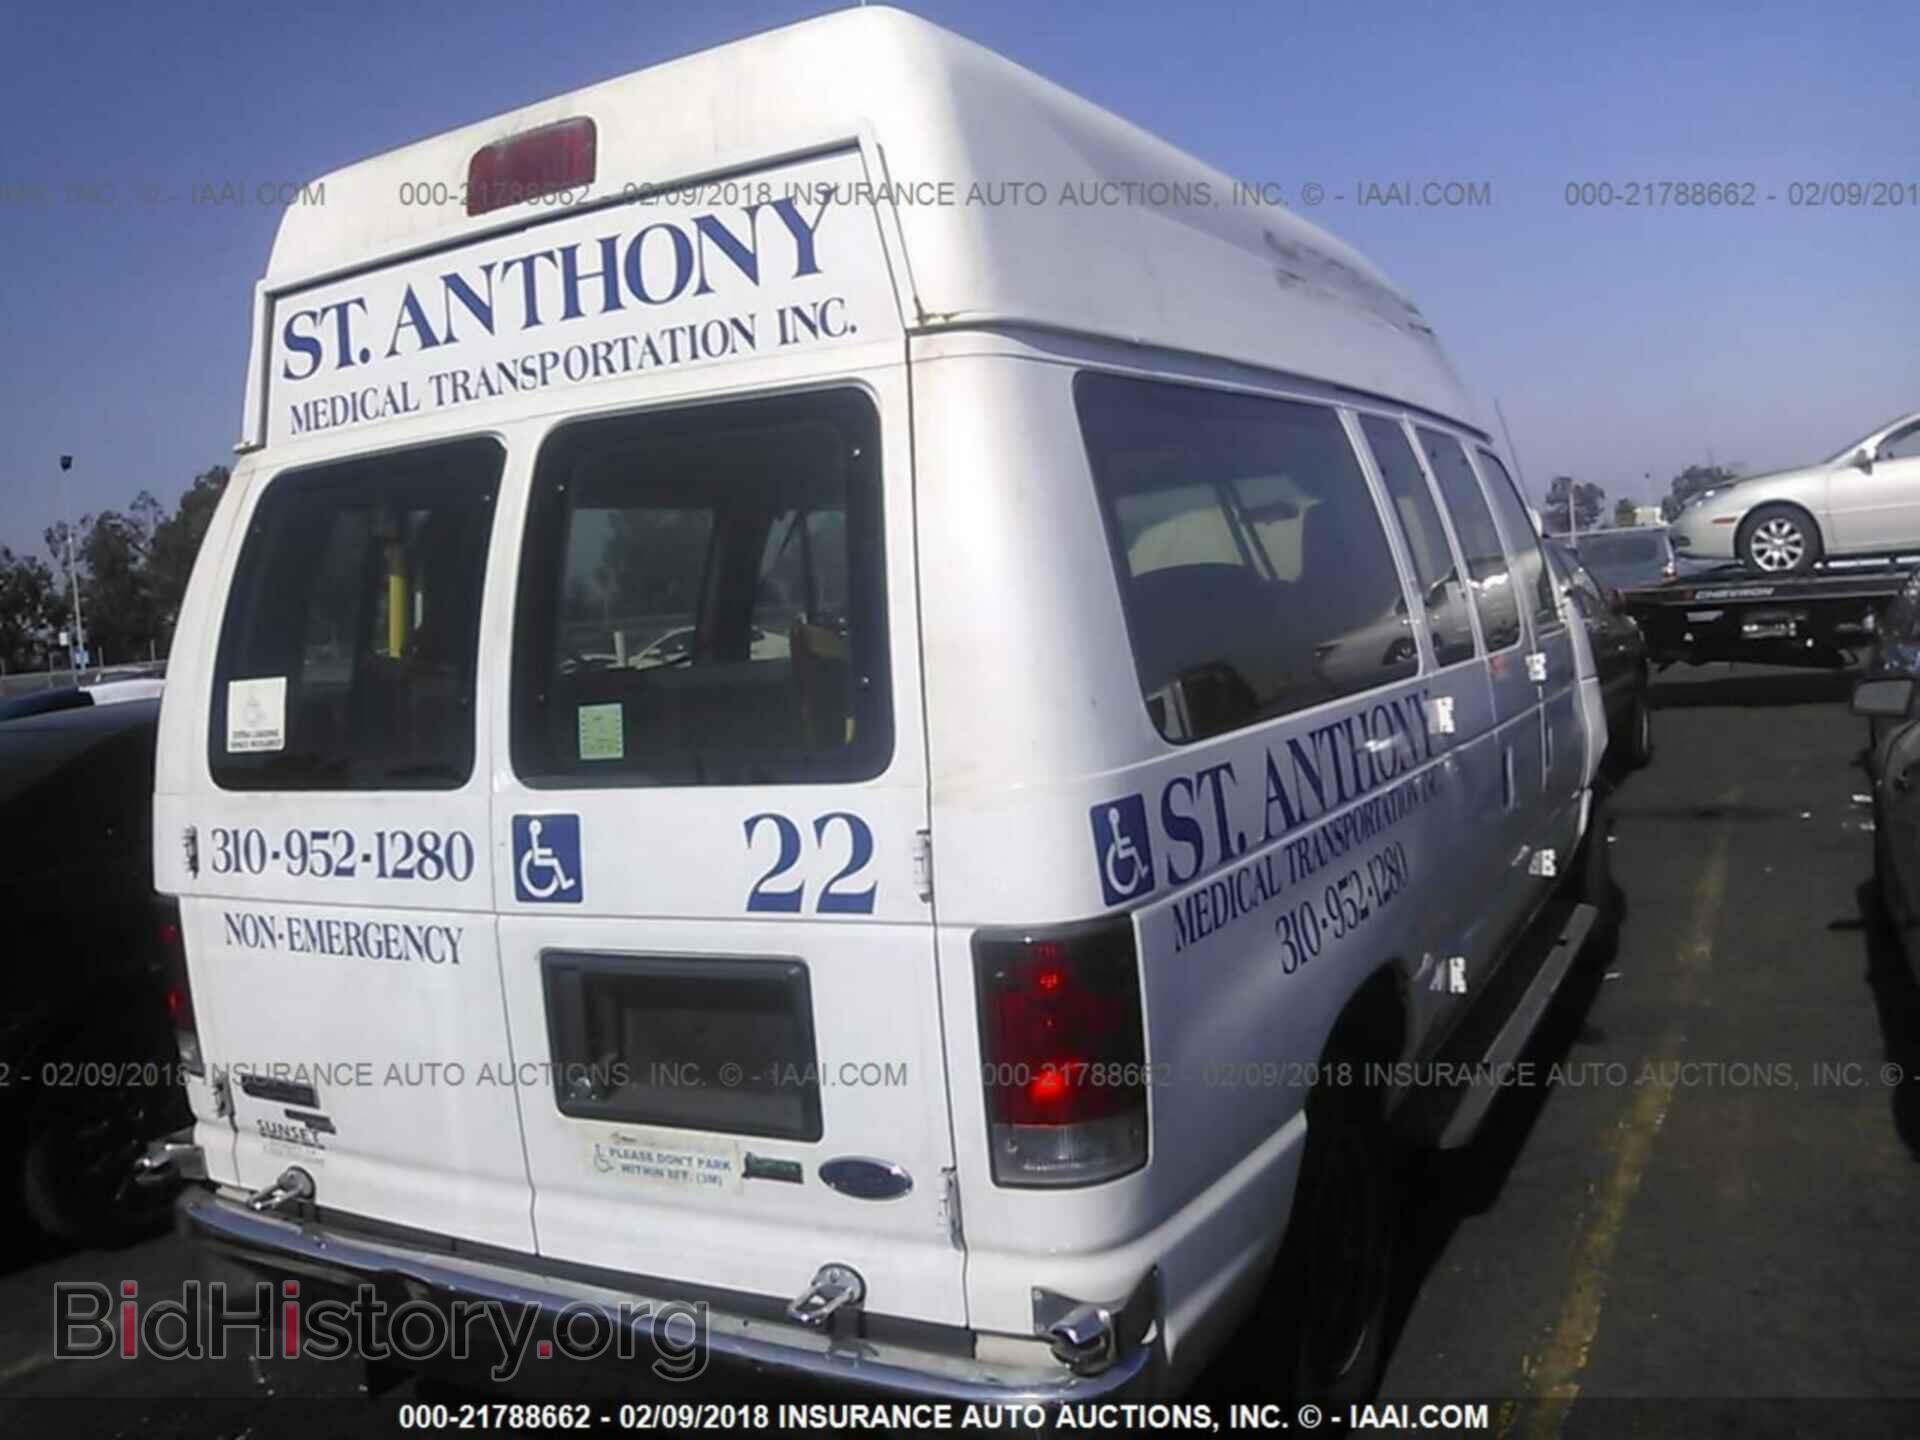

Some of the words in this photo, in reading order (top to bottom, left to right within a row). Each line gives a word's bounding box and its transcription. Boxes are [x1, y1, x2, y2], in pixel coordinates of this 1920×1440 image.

[281, 296, 371, 381] ST.
[385, 186, 837, 358] ANTHONY
[289, 382, 420, 435] MEDICAL
[428, 313, 758, 404] TRANSPORTATION
[776, 297, 858, 347] INC.
[1160, 761, 1247, 886] ST.
[1260, 688, 1433, 842] ANTHONY
[210, 827, 474, 882] 310-952-1280
[743, 812, 879, 915] 22
[1172, 853, 1281, 953] MEDICAL
[224, 911, 465, 966] NON-EMERGENCY
[256, 1118, 321, 1145] SUNSET
[609, 1147, 653, 1163] PLEASE
[696, 1156, 732, 1171] PARK
